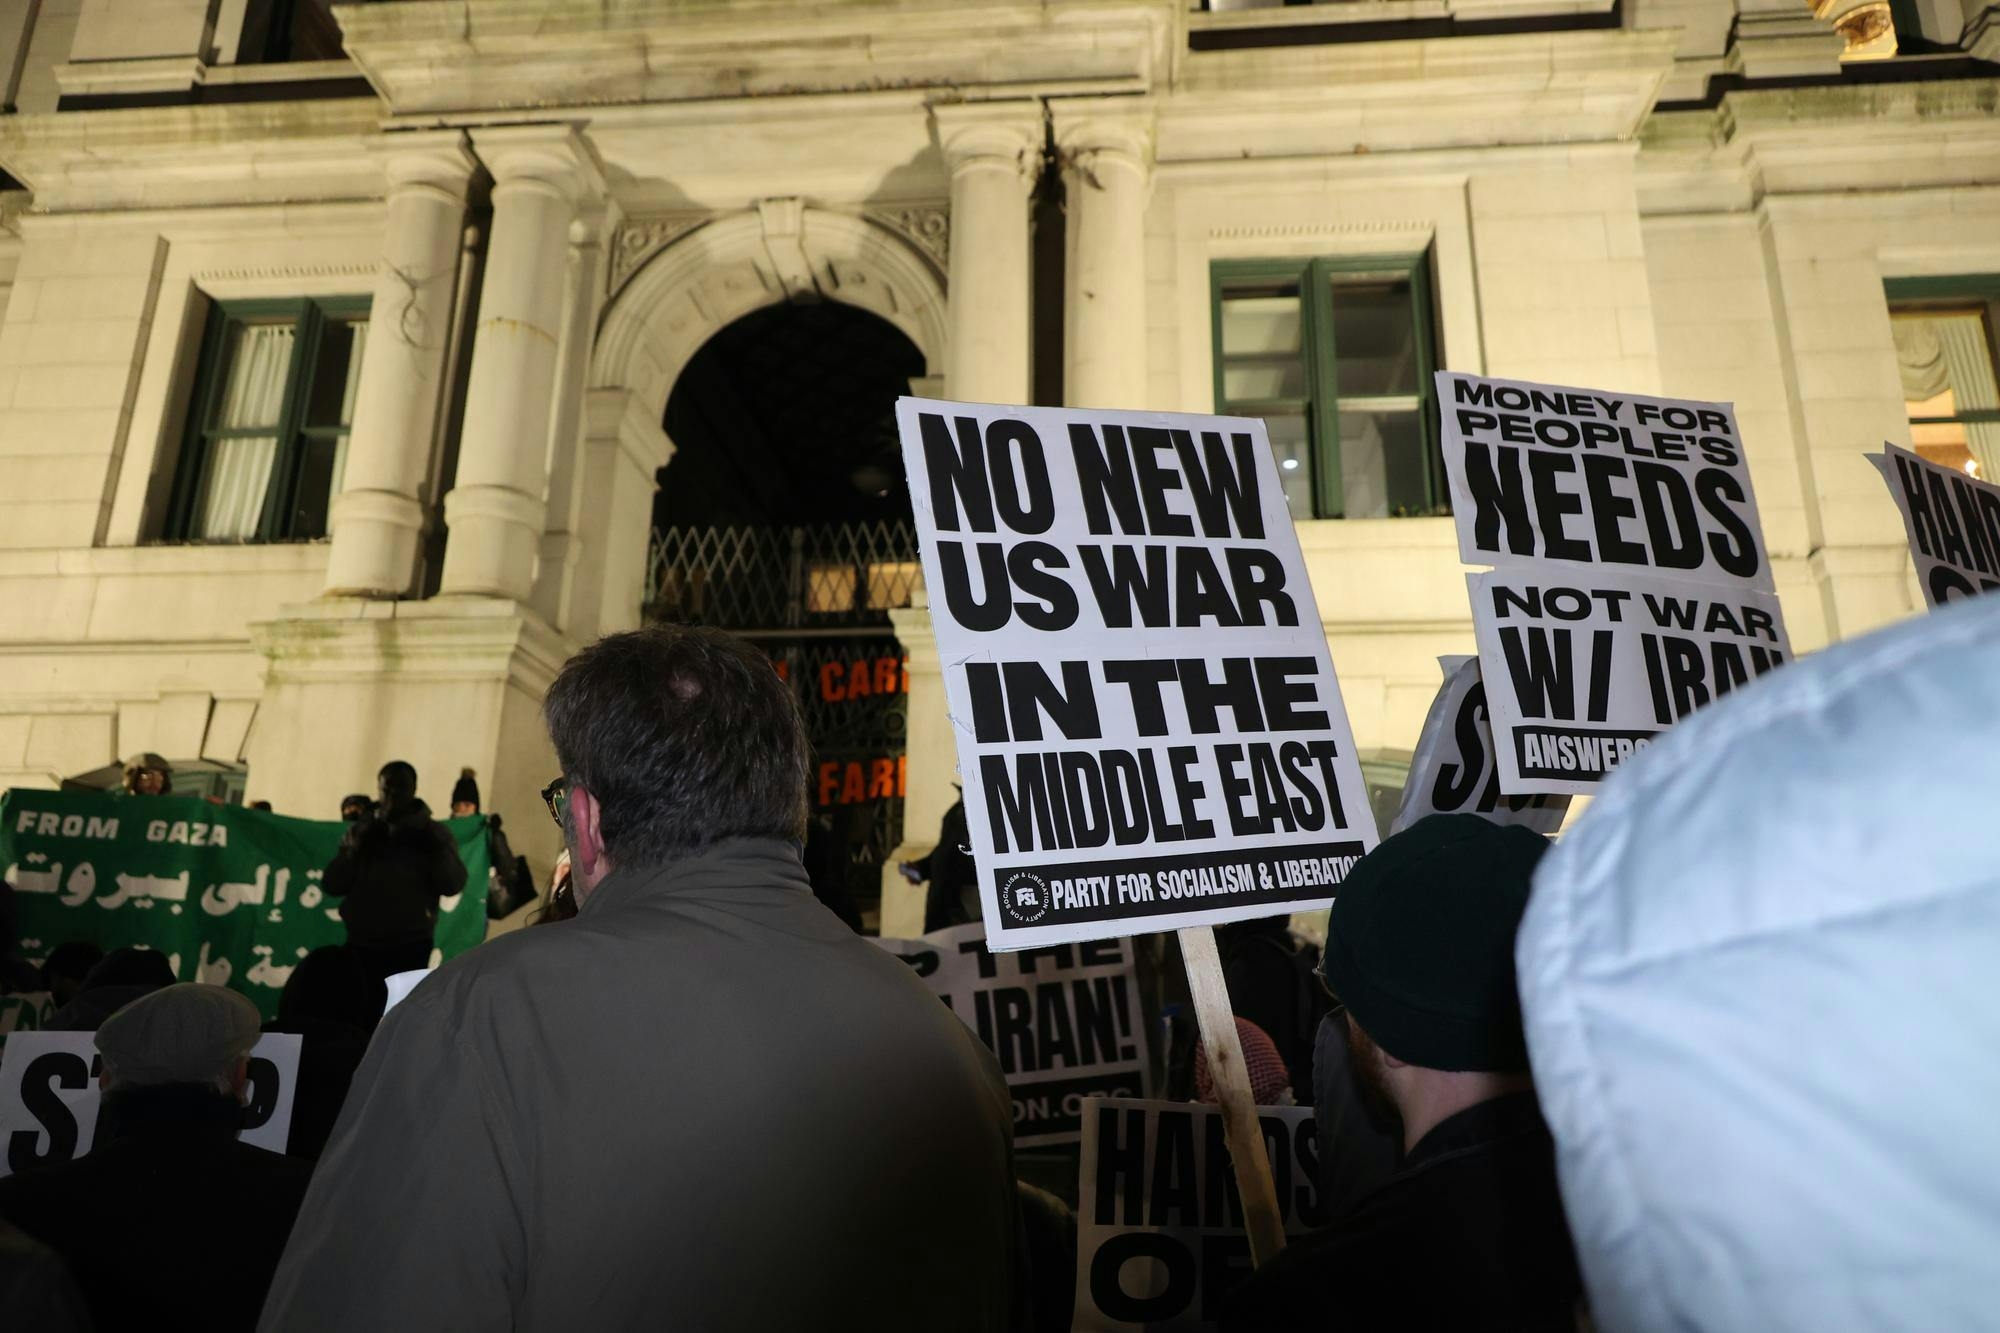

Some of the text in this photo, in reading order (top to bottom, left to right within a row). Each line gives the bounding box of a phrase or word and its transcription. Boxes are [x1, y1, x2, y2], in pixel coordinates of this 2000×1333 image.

[1454, 379, 1731, 434] MONEY FOR
[1455, 409, 1739, 467] PEOPLE'S
[919, 413, 1266, 540] NO NEW
[1464, 441, 1758, 578] NEEDS
[937, 541, 1299, 631] US WAR
[1491, 585, 1778, 642] NOT WAR
[820, 655, 909, 703] CAR
[964, 656, 1331, 743] IN THE
[1498, 626, 1613, 722] W/
[978, 746, 1216, 854] MIDDLE
[1215, 740, 1348, 836] EAST
[16, 810, 228, 847] FROM GAZA
[4, 852, 190, 916] بيروت
[1016, 890, 1039, 907] PSL
[1051, 855, 1362, 910] PARTY FOR SOCIALISM & LIBERATIO
[1009, 909, 1024, 922] FOR
[1026, 909, 1045, 922] PARTY
[974, 975, 1137, 1074] IRAN!
